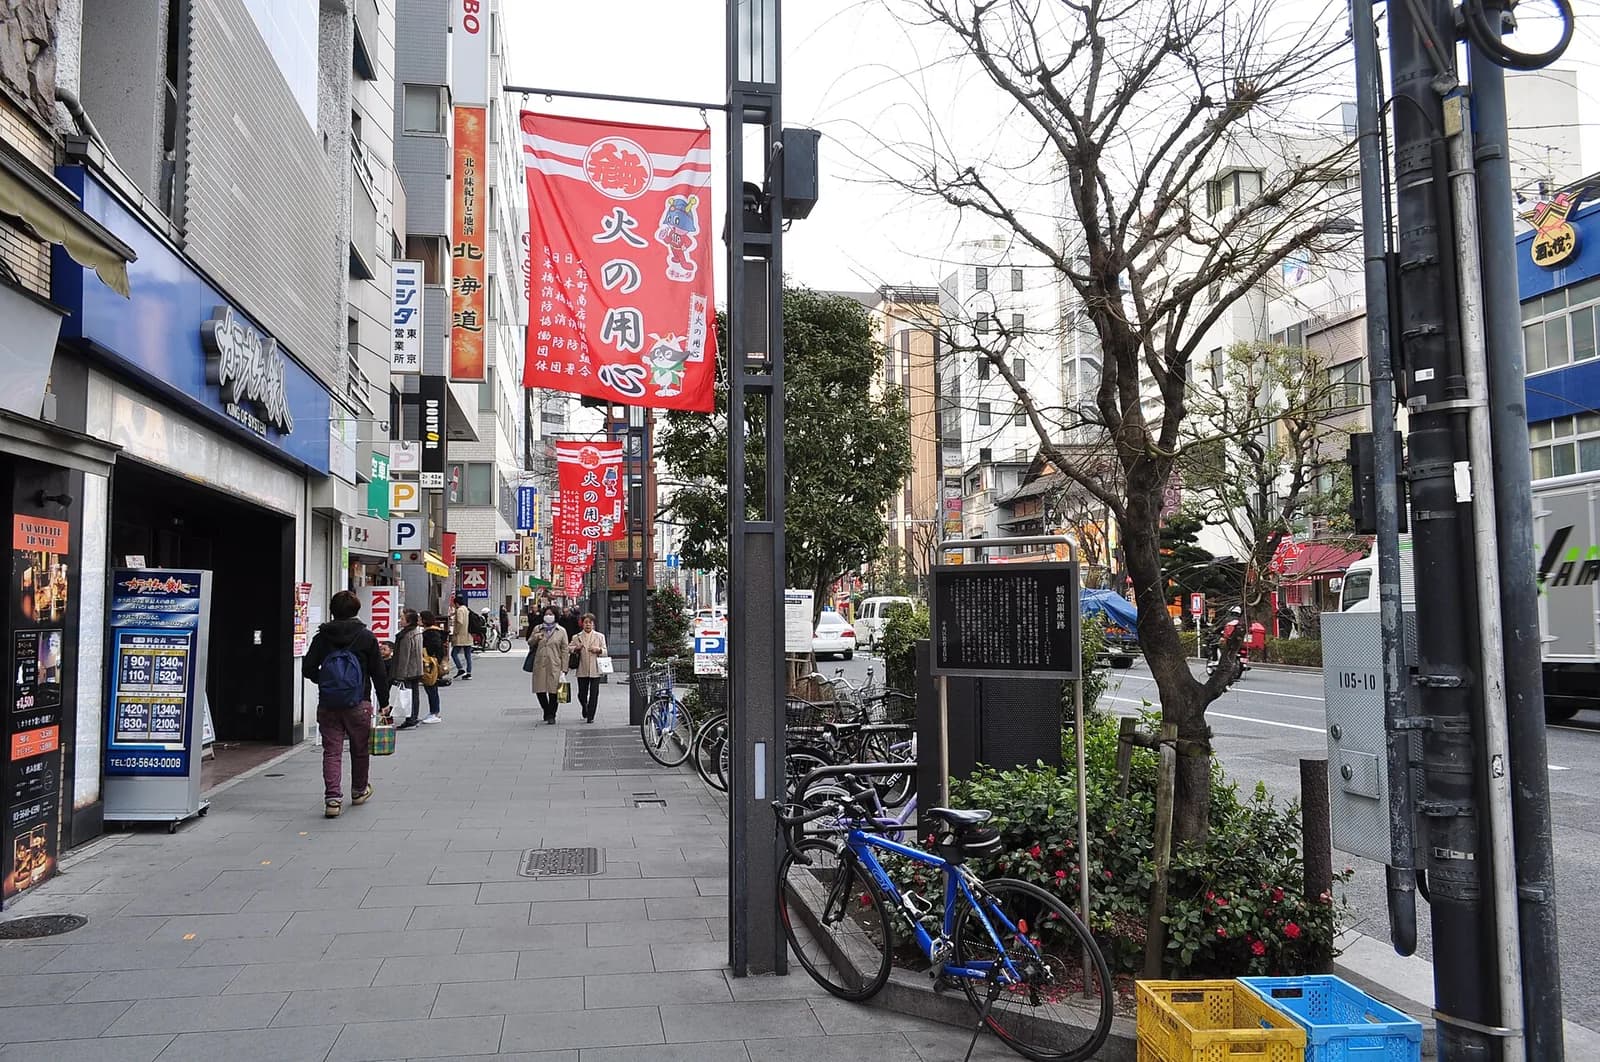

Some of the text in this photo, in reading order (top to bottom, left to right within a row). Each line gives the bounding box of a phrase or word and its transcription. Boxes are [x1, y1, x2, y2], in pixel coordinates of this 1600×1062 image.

[394, 268, 417, 325] ニシダ
[453, 243, 483, 333] 北海道
[591, 206, 649, 398] 火の用心
[394, 328, 404, 364] 営業所
[407, 328, 417, 364] 東京
[426, 400, 440, 448] DOUTOR
[394, 485, 414, 507] P
[582, 471, 600, 537] 火の用心
[397, 523, 415, 545] P
[508, 542, 519, 552] 本
[464, 568, 485, 587] 本
[372, 591, 390, 642] KIRI
[700, 638, 719, 653] P
[1339, 671, 1376, 690] 105-10
